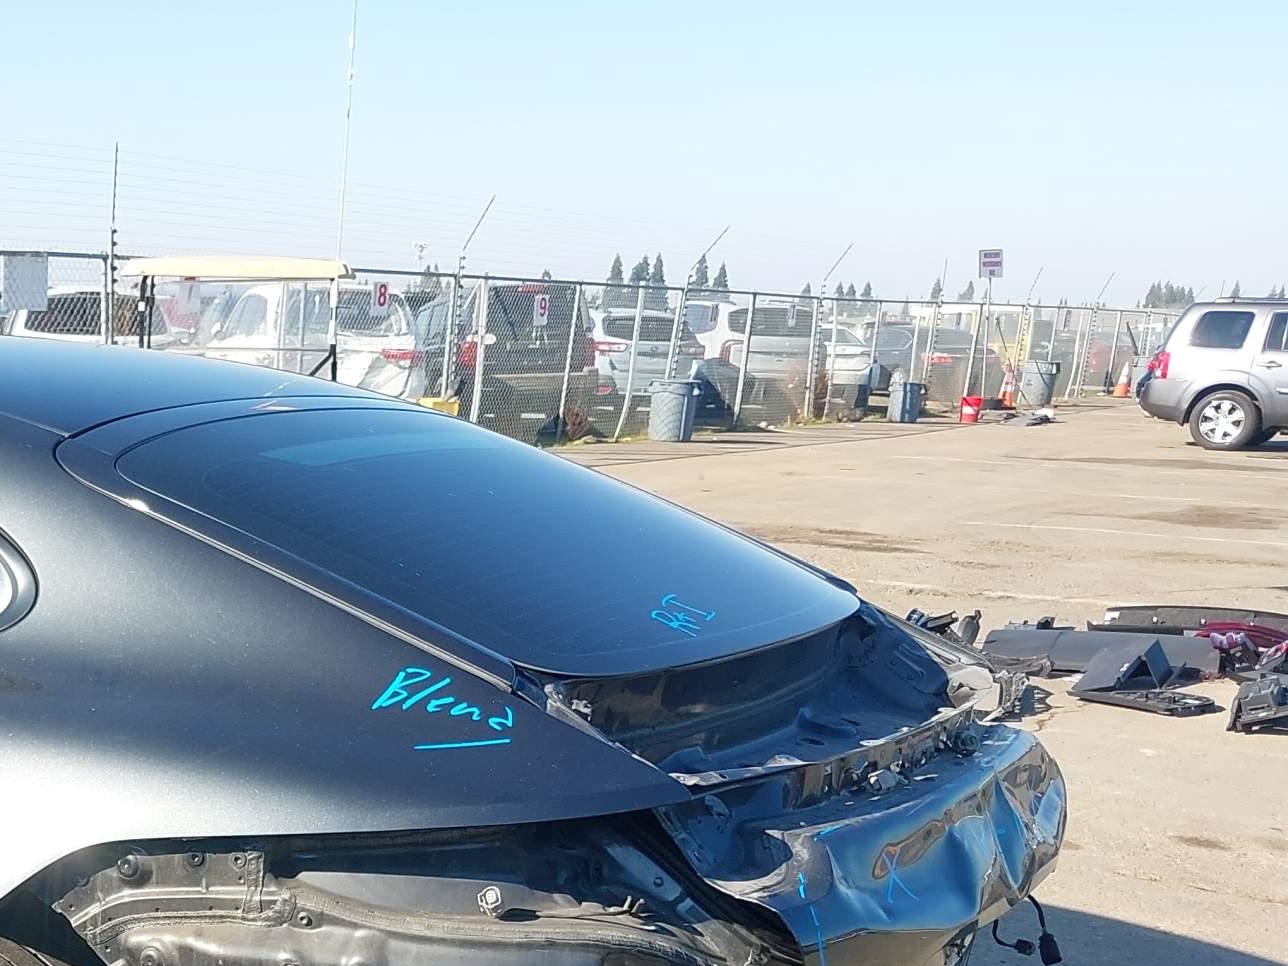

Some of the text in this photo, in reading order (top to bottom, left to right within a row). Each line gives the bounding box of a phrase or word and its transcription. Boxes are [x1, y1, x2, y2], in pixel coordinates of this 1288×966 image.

[378, 283, 388, 307] 8
[539, 297, 547, 317] 9
[372, 668, 513, 731] Blend
